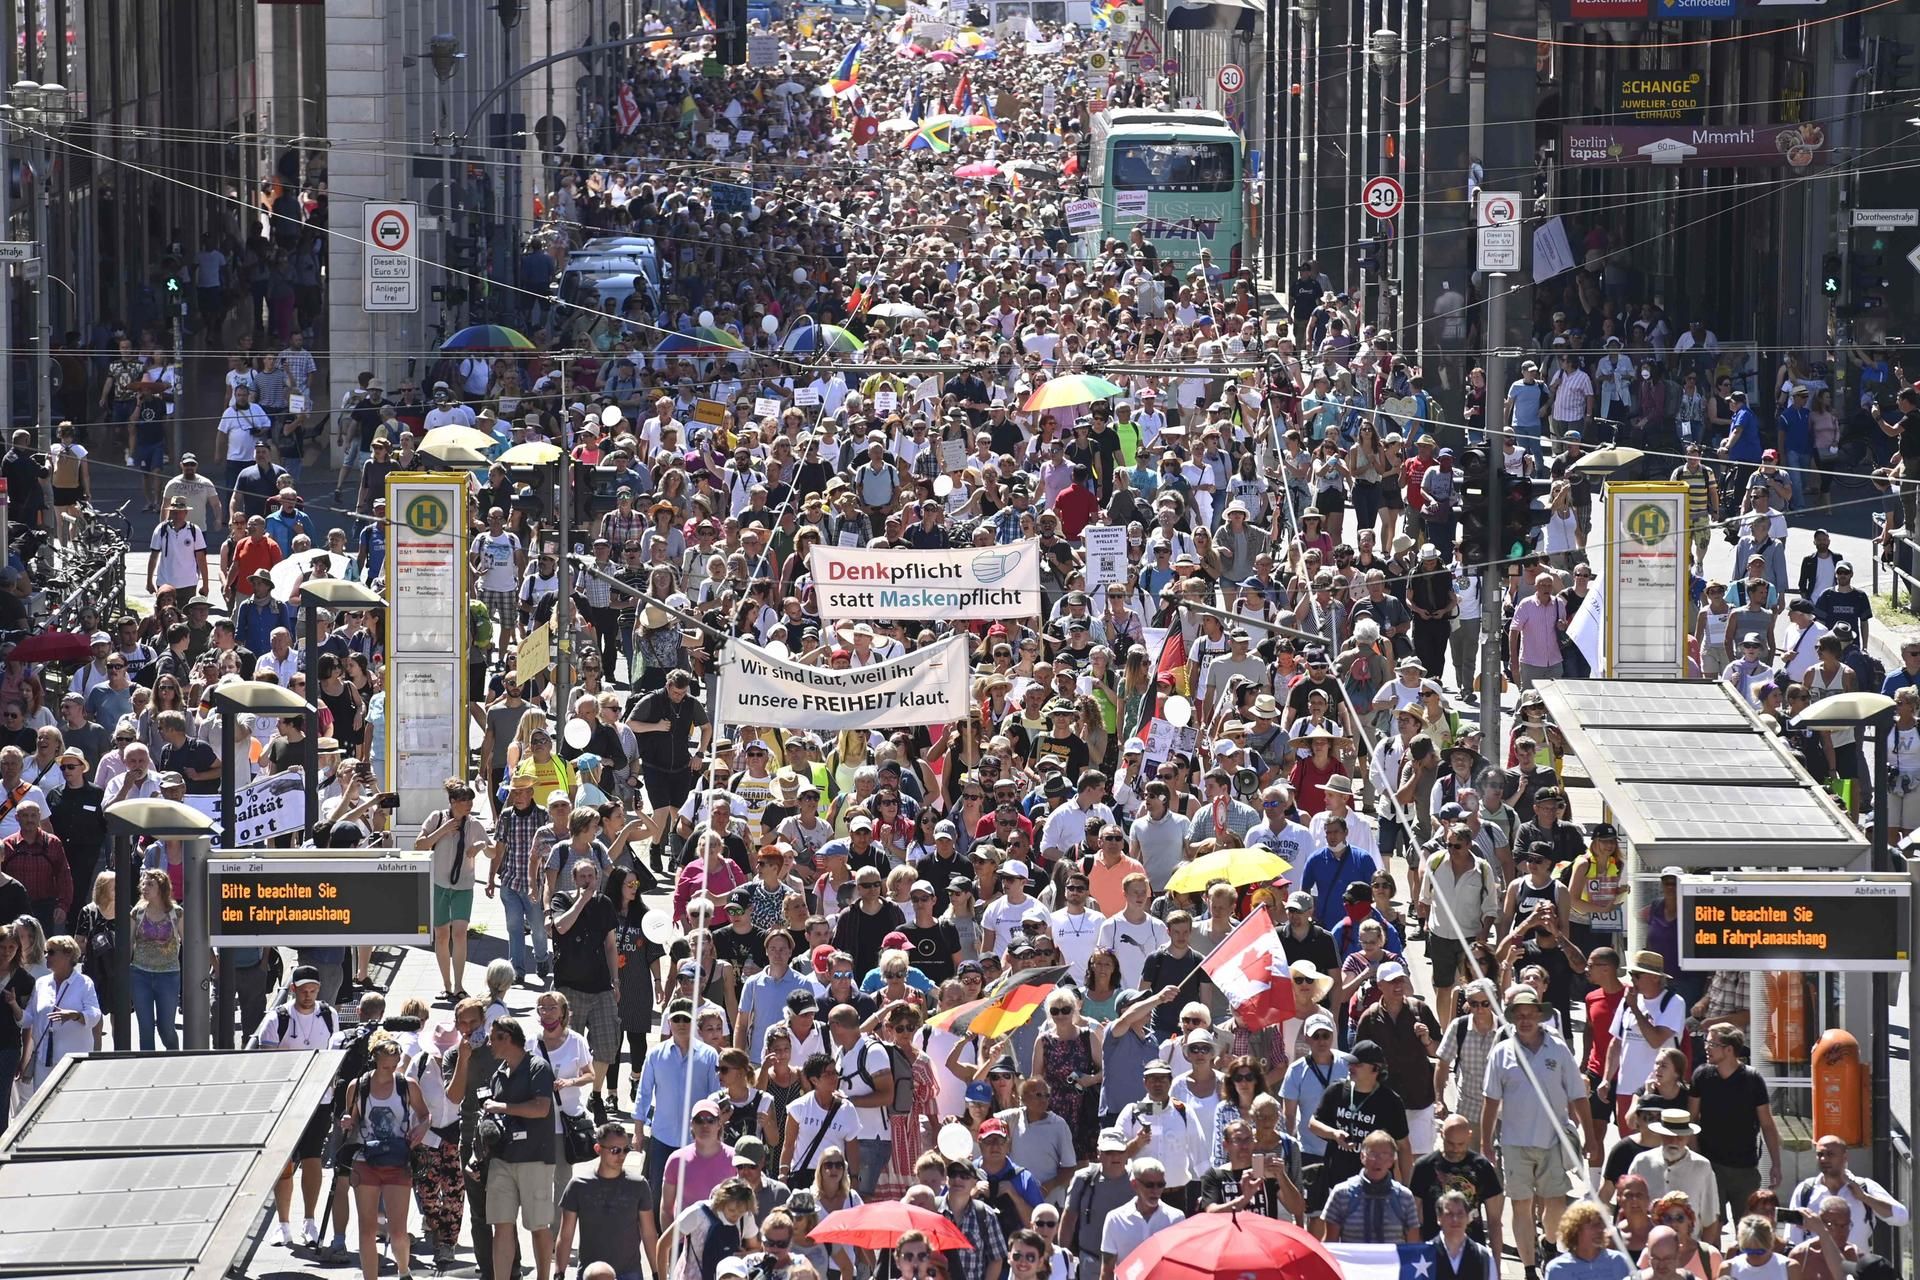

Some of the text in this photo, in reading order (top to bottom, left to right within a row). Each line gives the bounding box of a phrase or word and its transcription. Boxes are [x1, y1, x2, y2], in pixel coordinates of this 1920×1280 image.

[1223, 72, 1238, 85] 30
[1621, 99, 1697, 109] JUWELIER GOLD
[1635, 110, 1682, 119] LEIHHAUS
[1570, 137, 1607, 148] berlin
[1693, 130, 1754, 145] Mmmh!
[1570, 149, 1607, 161] tapas
[1371, 188, 1394, 207] 30
[1066, 201, 1098, 213] CORONA
[1856, 213, 1914, 222] Dorotheenstraße
[0, 247, 23, 258] straße
[373, 258, 408, 266] Diesel bis
[375, 285, 406, 294] Anlieger
[384, 294, 397, 302] frei
[829, 562, 962, 584] Denkpflicht
[830, 588, 1022, 609] statt Maskenpflicht
[741, 659, 916, 687] Wir sind laut, weil ihr
[738, 690, 949, 712] unsere FREIHEIT klaut.
[222, 864, 417, 872] Linie Ziel Abfahrt in
[222, 882, 337, 899] Bitte beachten Sie
[1855, 887, 1886, 895] Abfahrt
[222, 906, 351, 925] den Fahrplanaushang
[1695, 906, 1814, 922] Bitte beachten Sie
[1695, 929, 1827, 949] den Fahrplanaushang
[622, 943, 637, 952] YOU
[1336, 1107, 1376, 1125] Merkel
[1352, 1126, 1370, 1138] der
